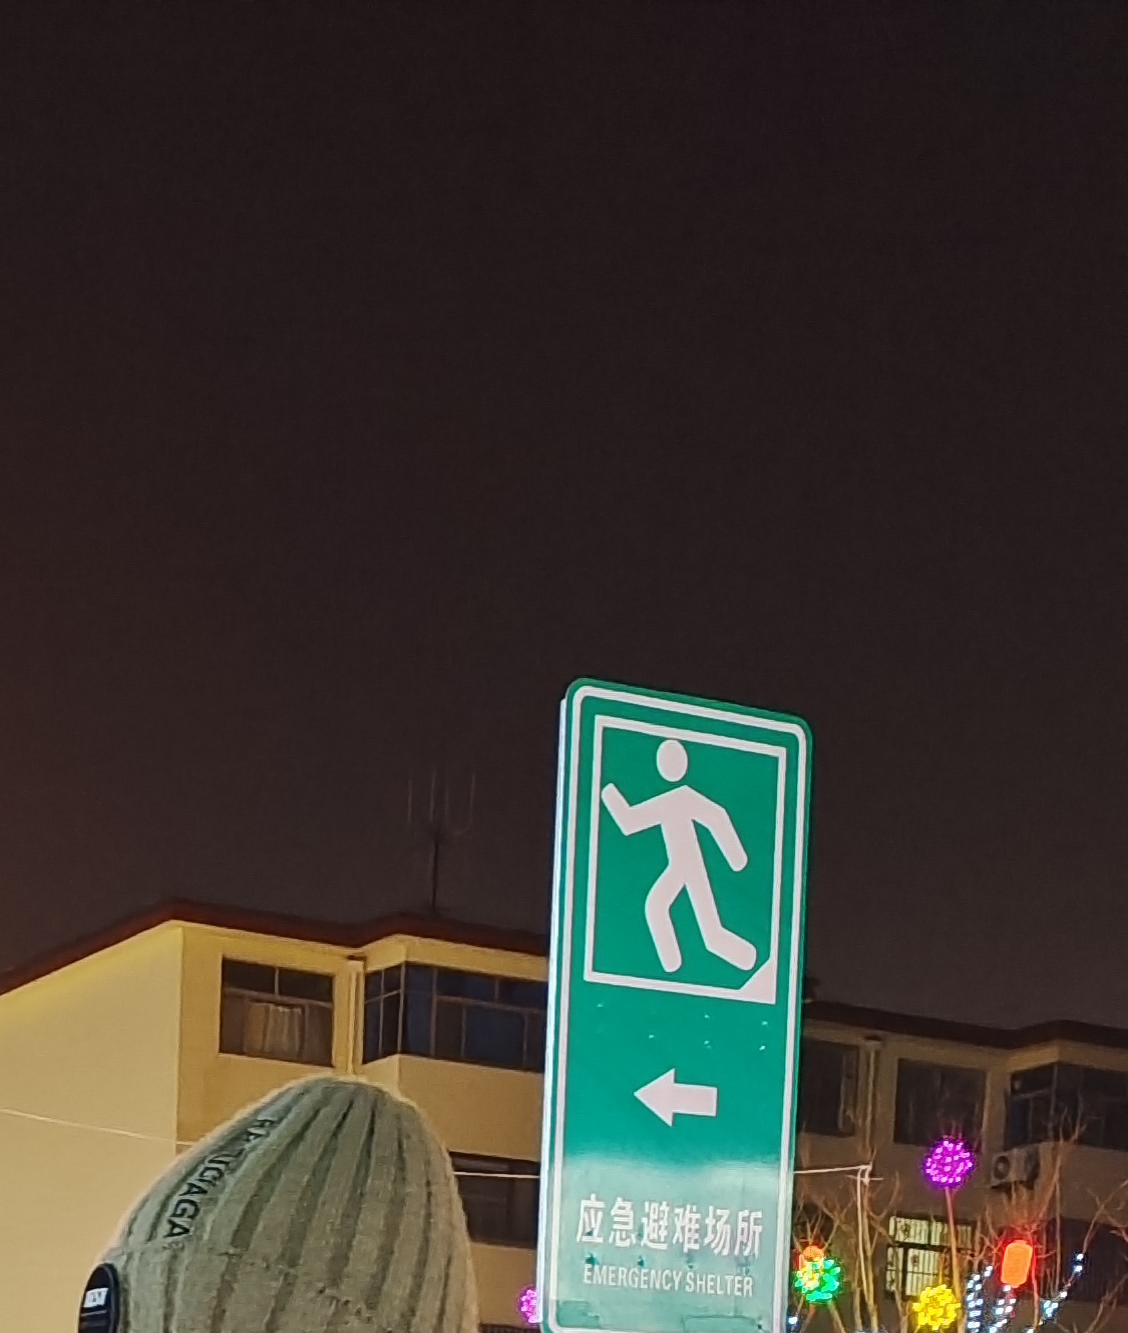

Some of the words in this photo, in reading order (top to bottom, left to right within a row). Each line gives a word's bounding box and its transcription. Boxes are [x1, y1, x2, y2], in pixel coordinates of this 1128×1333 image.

[576, 1193, 764, 1258] 应急避难场所
[583, 1263, 682, 1292] EMERGENCY
[685, 1271, 754, 1298] SHELTER
